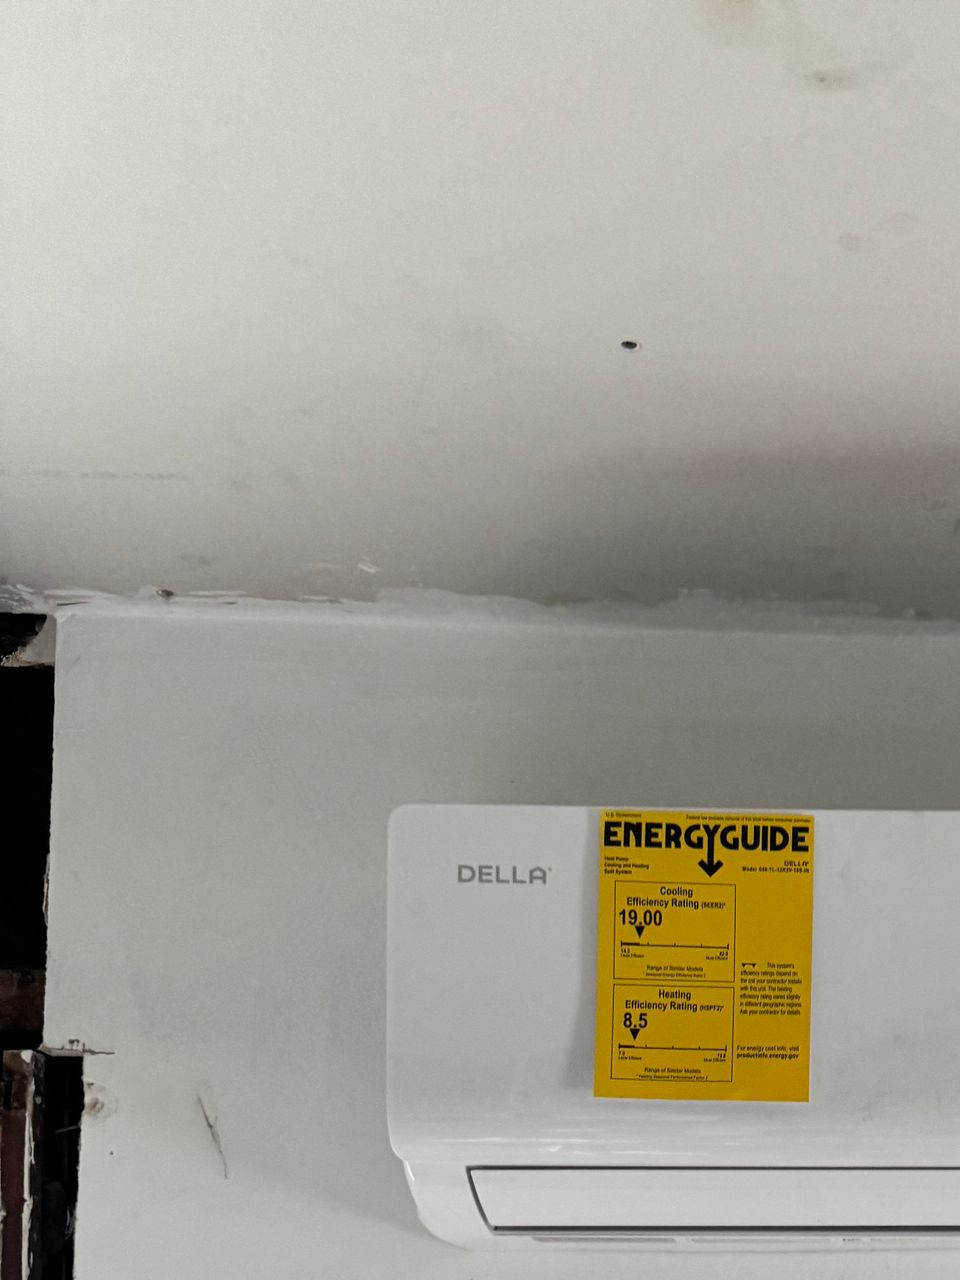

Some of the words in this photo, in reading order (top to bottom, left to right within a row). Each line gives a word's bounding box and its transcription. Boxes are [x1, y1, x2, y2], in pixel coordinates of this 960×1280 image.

[604, 821, 809, 853] ENERGYGUIDE
[457, 864, 547, 885] DELLA
[660, 886, 693, 898] Cooling
[627, 897, 669, 909] Efficiency
[671, 898, 699, 910] Rating
[619, 908, 663, 926] 19.00
[659, 989, 691, 1001] Heating
[625, 1000, 667, 1012] Efficiency
[670, 1001, 698, 1013] Rating
[623, 1012, 648, 1029] 8.5
